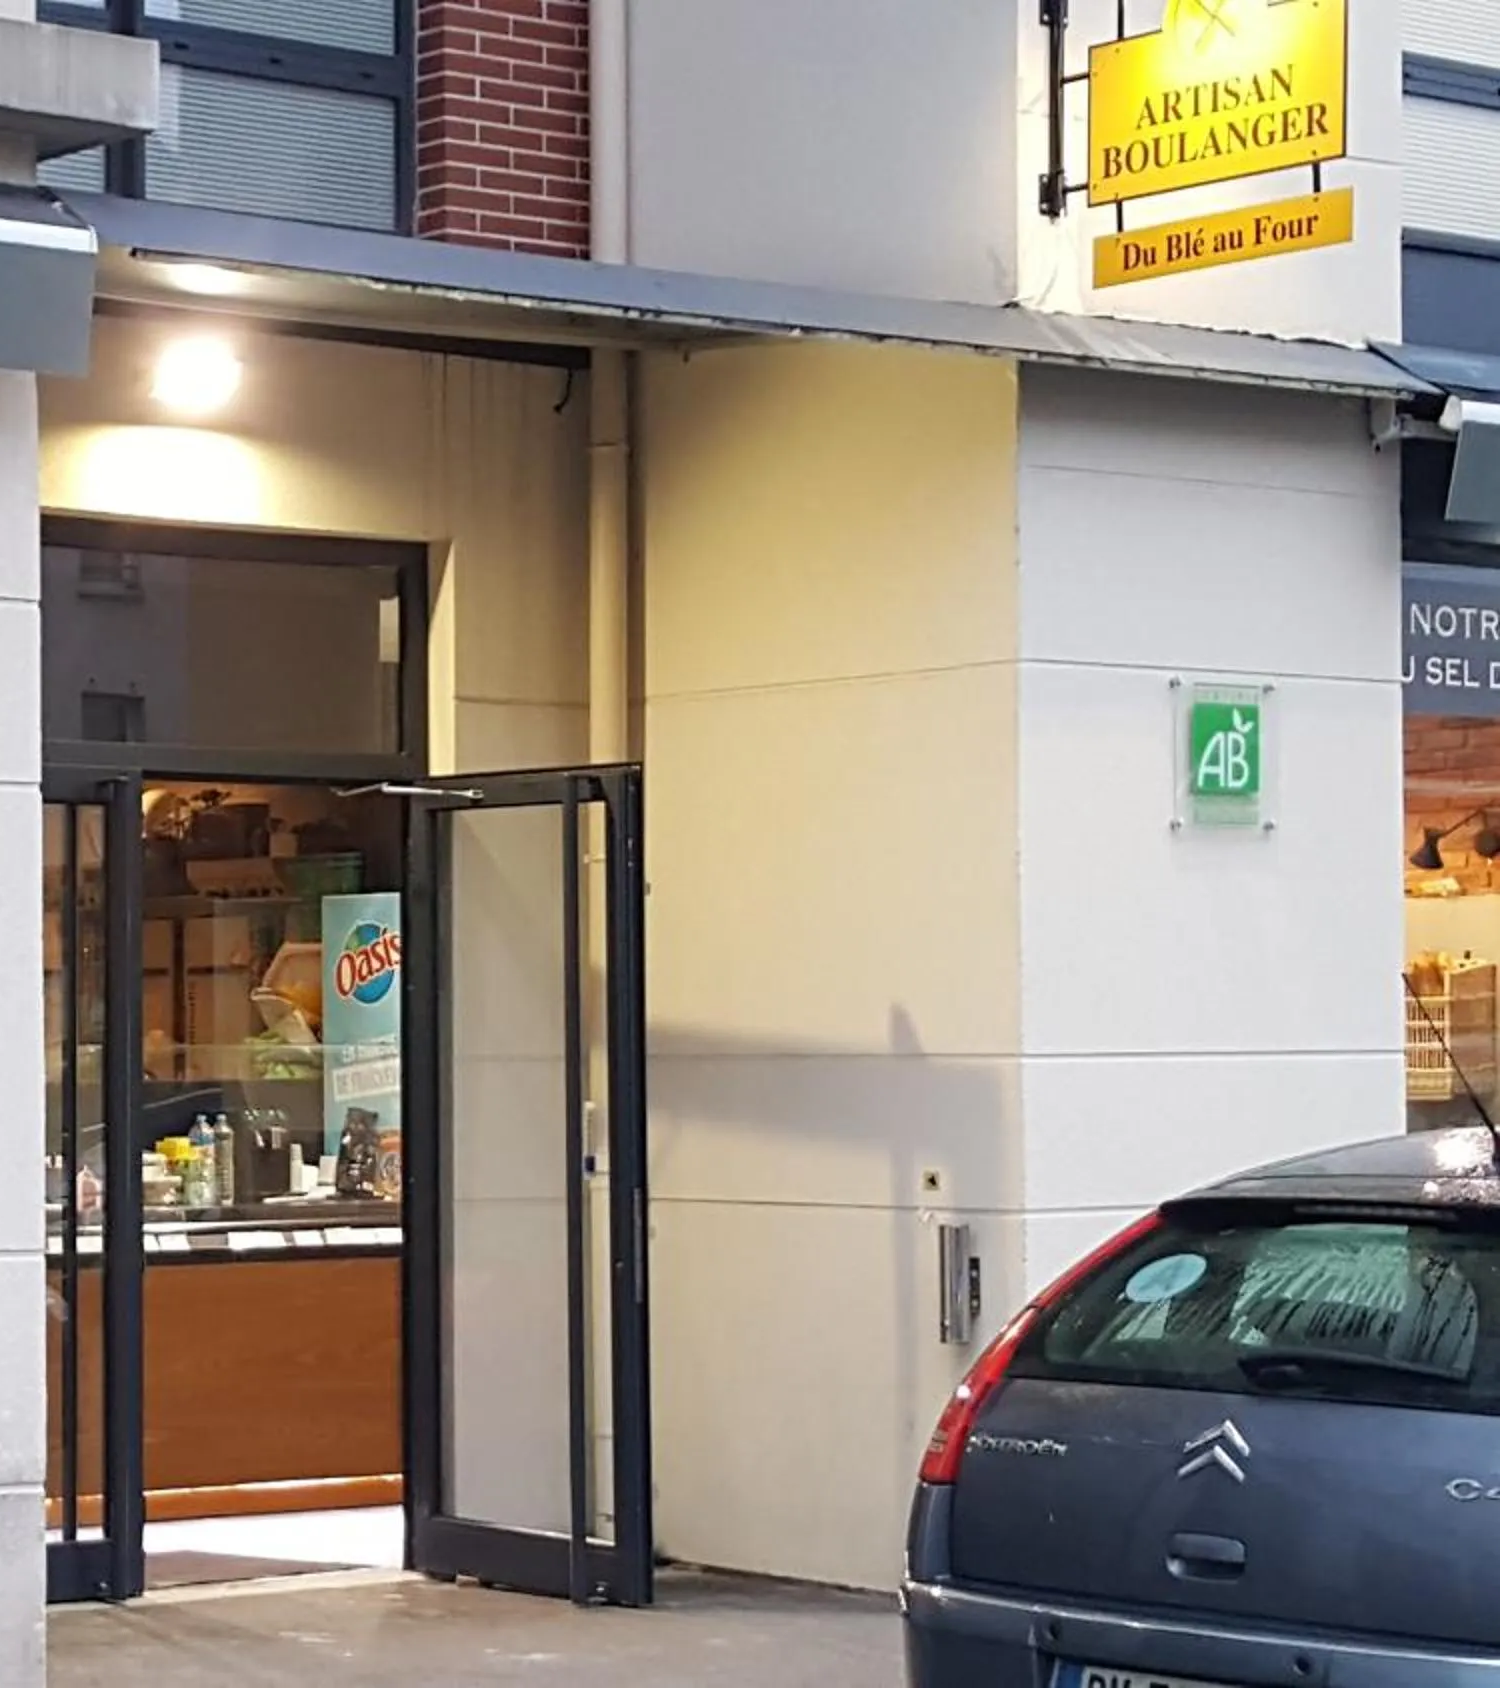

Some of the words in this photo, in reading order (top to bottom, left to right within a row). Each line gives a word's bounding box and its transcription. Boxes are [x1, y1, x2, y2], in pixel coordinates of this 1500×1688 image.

[1135, 63, 1295, 130] ARTISAN
[1101, 102, 1329, 180] BOULANGER
[1122, 241, 1157, 272] Du
[1166, 228, 1205, 263] Blé
[1213, 229, 1244, 253] au
[1253, 213, 1320, 246] Four
[1424, 656, 1480, 689] SEL
[334, 927, 403, 999] Oasis
